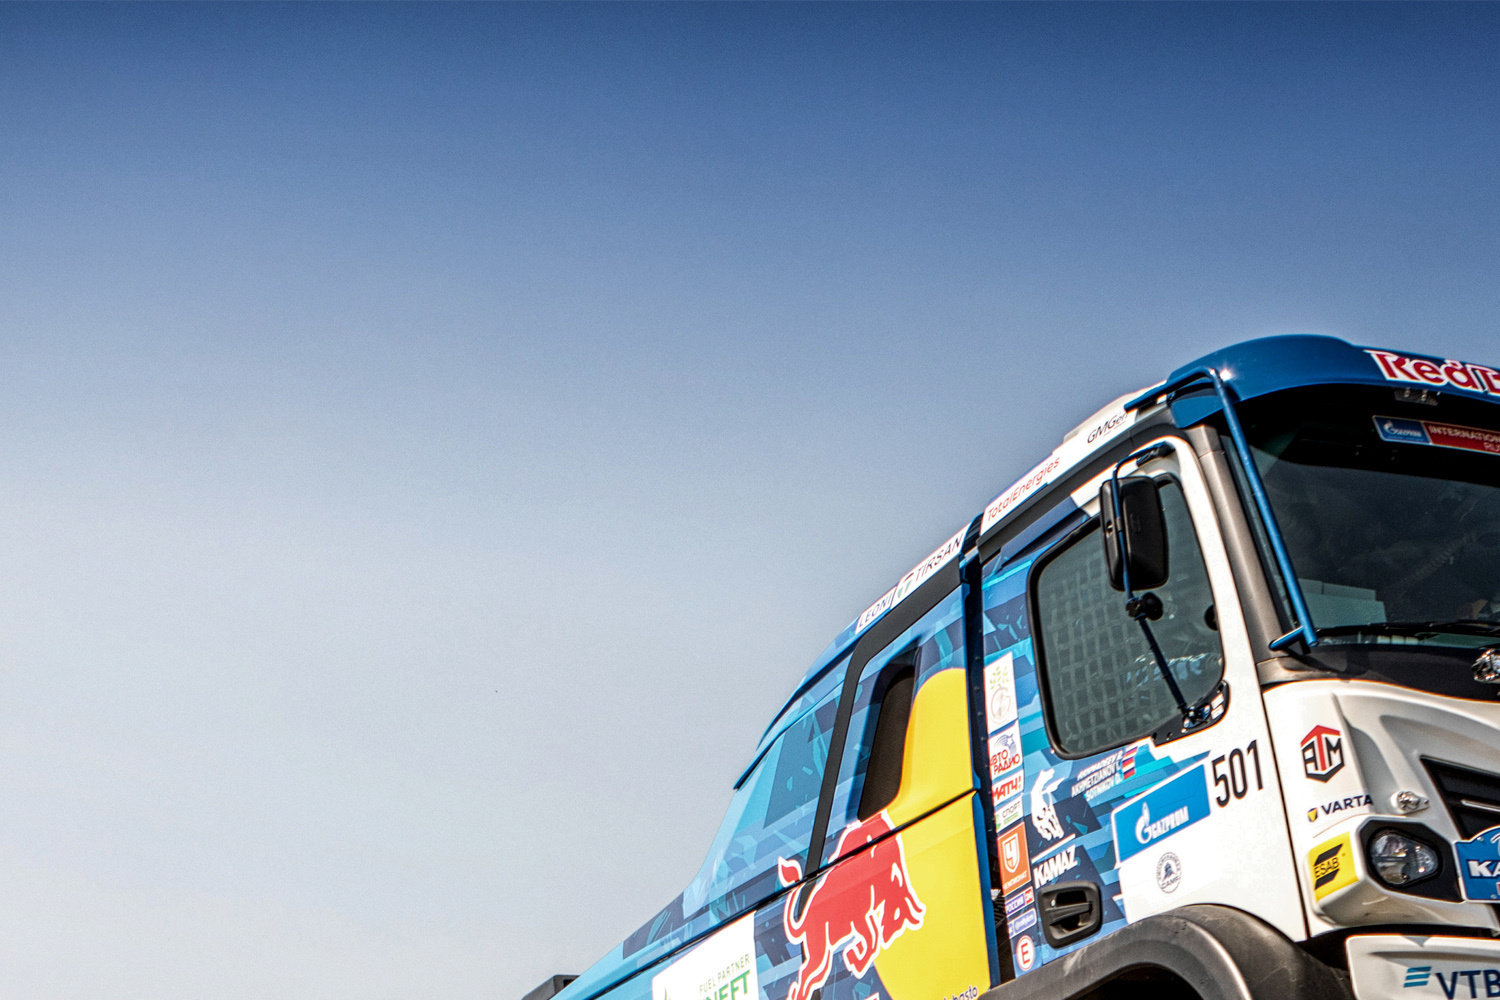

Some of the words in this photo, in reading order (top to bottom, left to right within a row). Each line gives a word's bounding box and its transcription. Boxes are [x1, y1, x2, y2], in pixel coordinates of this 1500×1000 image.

[987, 457, 1060, 522] TotalEnergies
[858, 593, 893, 628] LEONI
[994, 754, 1020, 776] РАДИО
[1211, 739, 1263, 808] 501
[1002, 801, 1020, 818] СПОРТ
[1321, 794, 1374, 816] VARTA
[1033, 844, 1078, 889] KAMAZ
[1314, 857, 1340, 879] ESAB
[1020, 942, 1030, 965] E
[699, 981, 716, 995] FUEL
[717, 953, 750, 984] PARTNER
